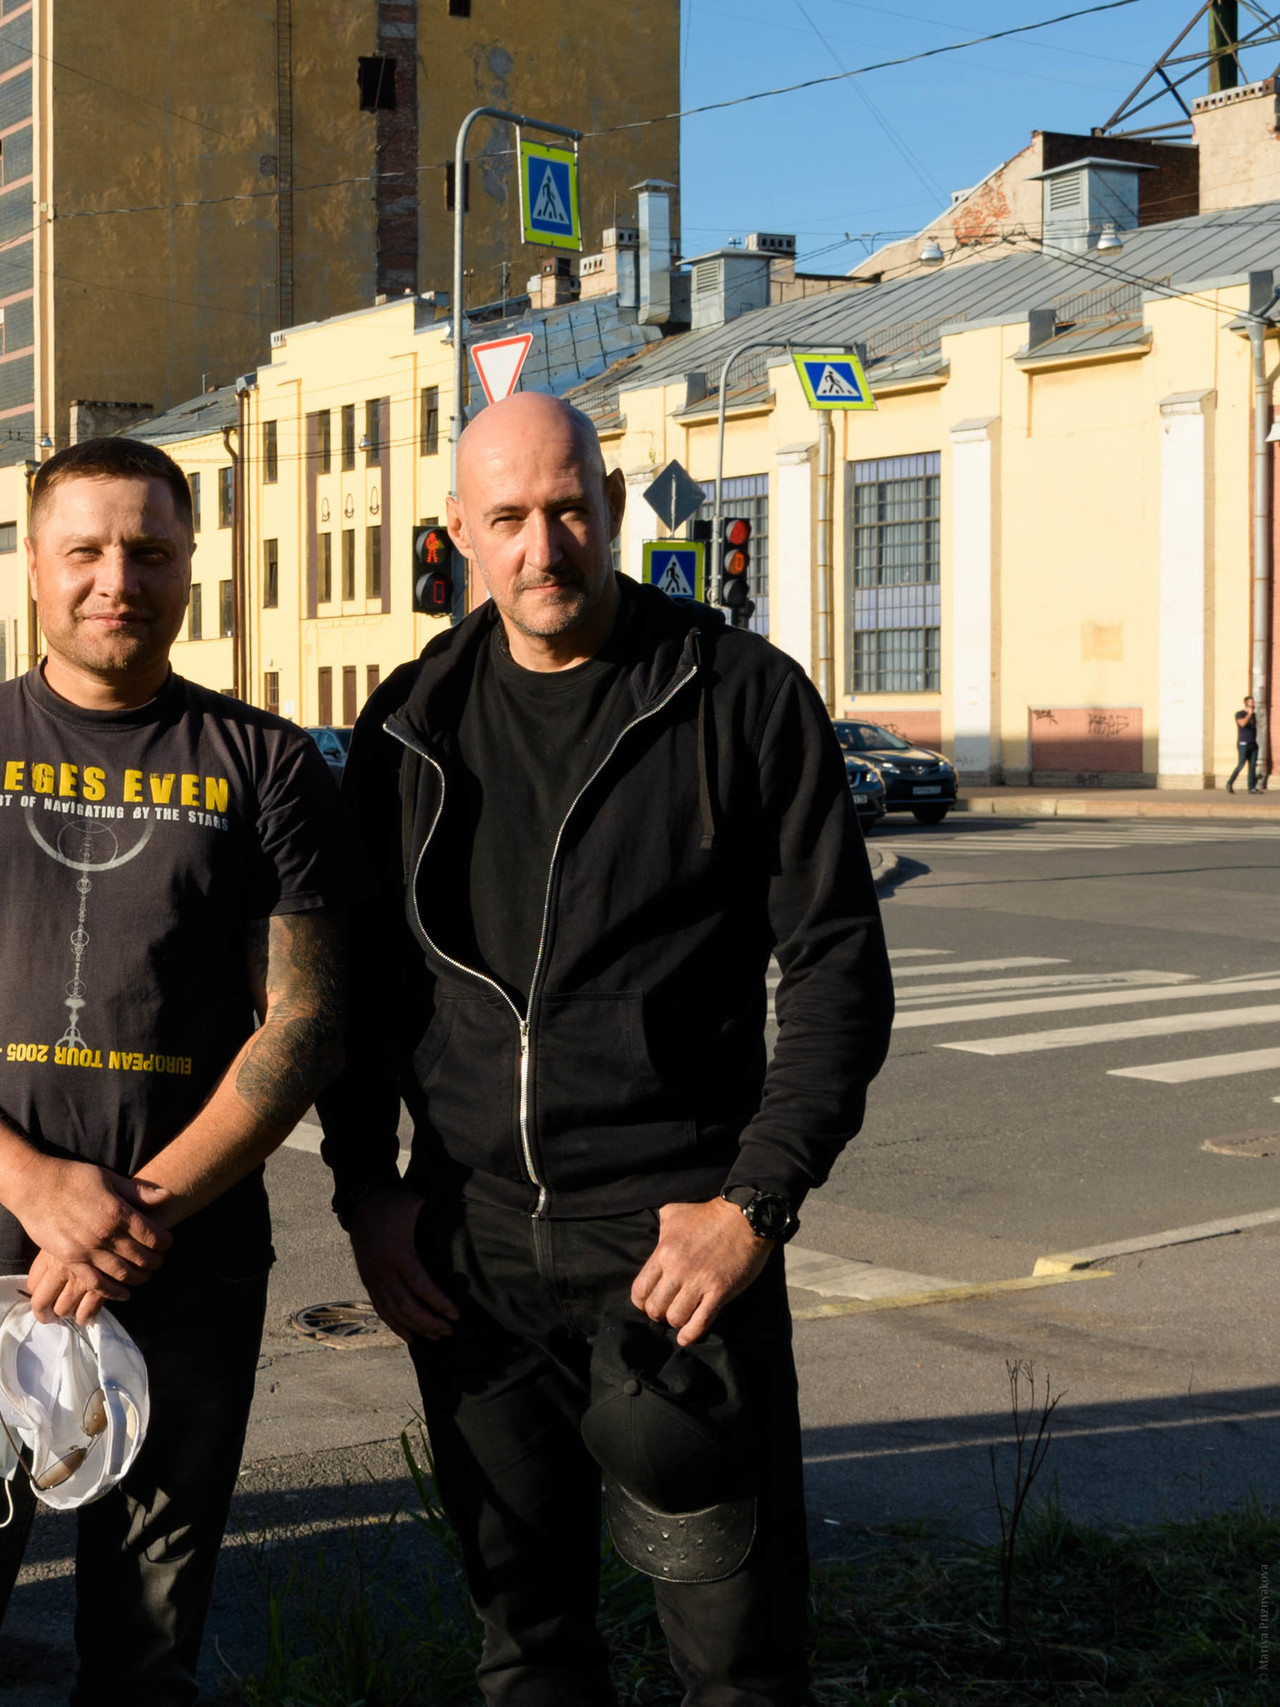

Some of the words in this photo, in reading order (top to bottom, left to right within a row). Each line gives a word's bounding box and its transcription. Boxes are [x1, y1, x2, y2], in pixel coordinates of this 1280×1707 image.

[123, 769, 229, 813] EVEN
[20, 794, 37, 808] OF
[44, 798, 125, 819] NAVIGATING
[132, 806, 150, 820] BY
[154, 806, 180, 821] THE
[188, 810, 229, 832] STARS
[6, 1043, 50, 1063] 2005
[54, 1045, 104, 1069] TOUR
[108, 1050, 192, 1075] EUROPEAN
